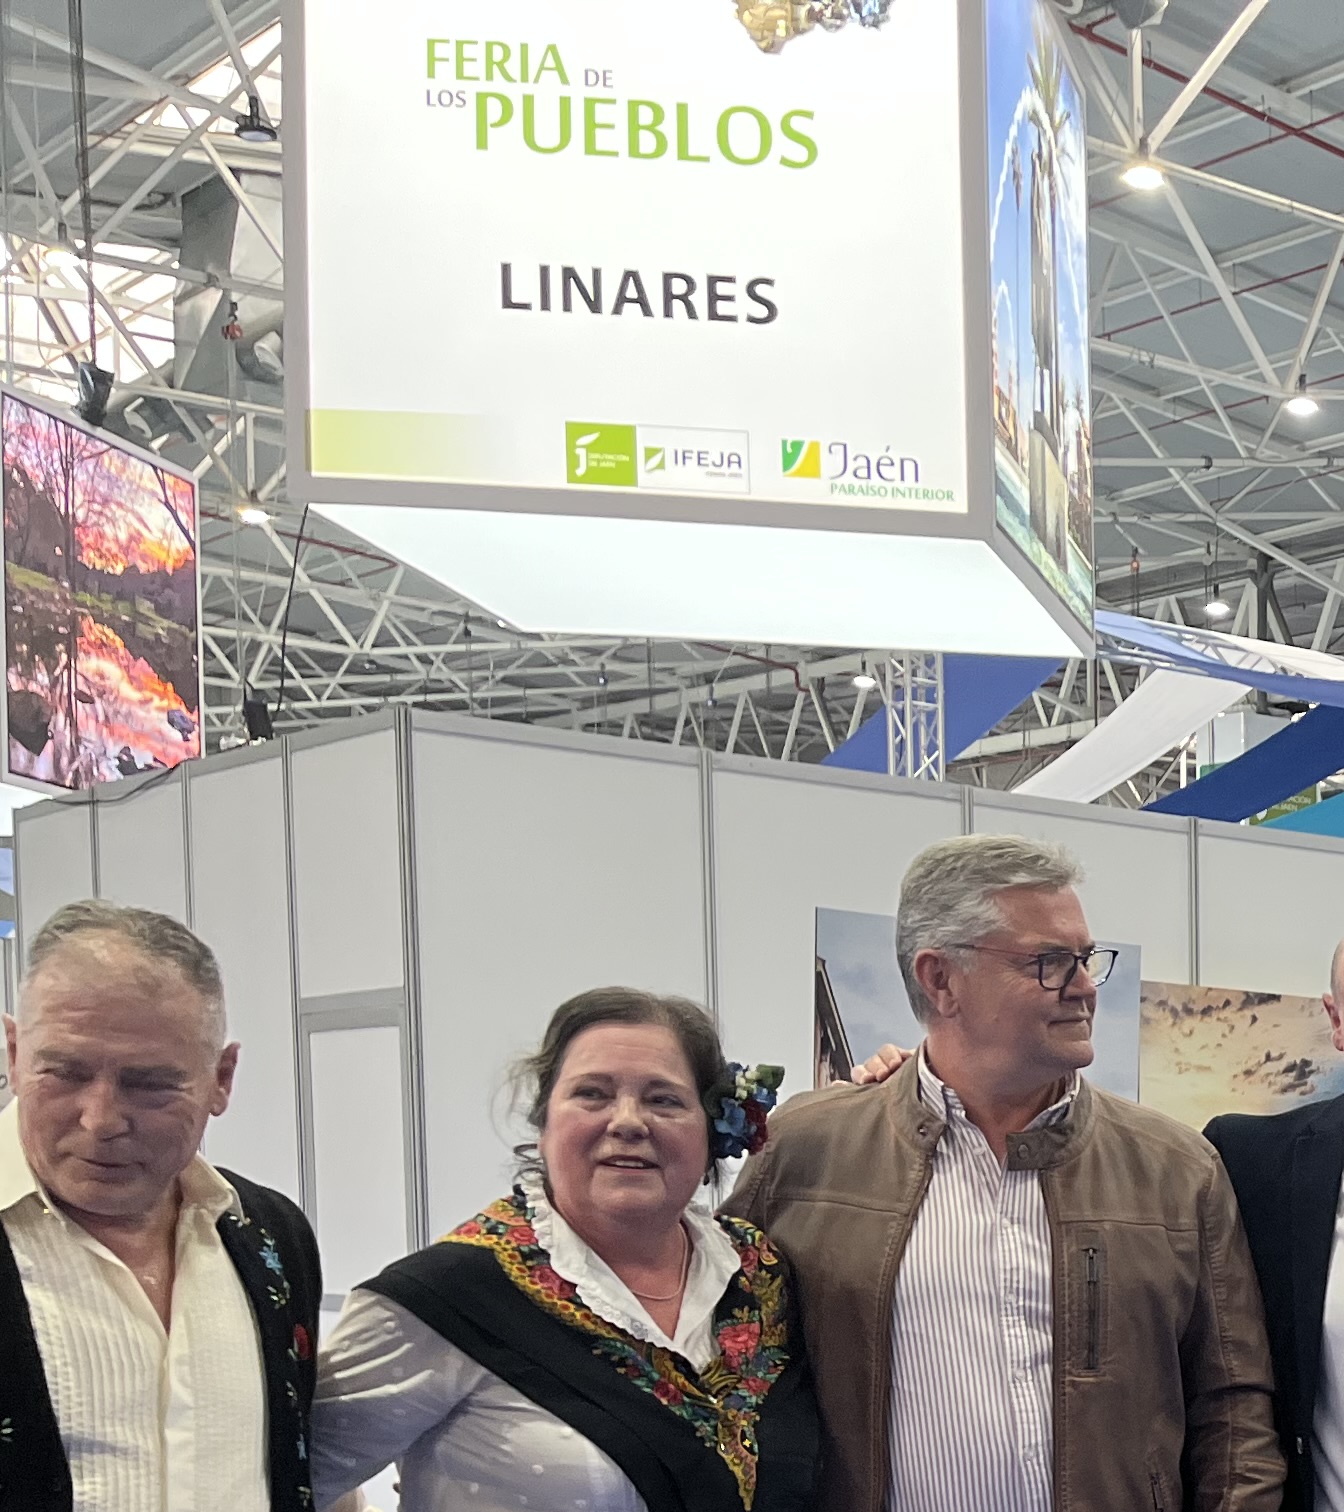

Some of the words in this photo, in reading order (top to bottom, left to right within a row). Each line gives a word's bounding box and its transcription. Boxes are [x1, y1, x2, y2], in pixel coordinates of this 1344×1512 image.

[426, 38, 570, 86] FERIA
[583, 68, 614, 89] DE
[426, 89, 466, 108] LOS
[475, 91, 818, 169] PUEBLOS
[501, 262, 779, 326] LINARES
[673, 449, 742, 470] IFEJA
[828, 442, 919, 483] Jaén
[830, 483, 889, 499] PARAÍSO
[890, 486, 955, 502] INTERIOR
